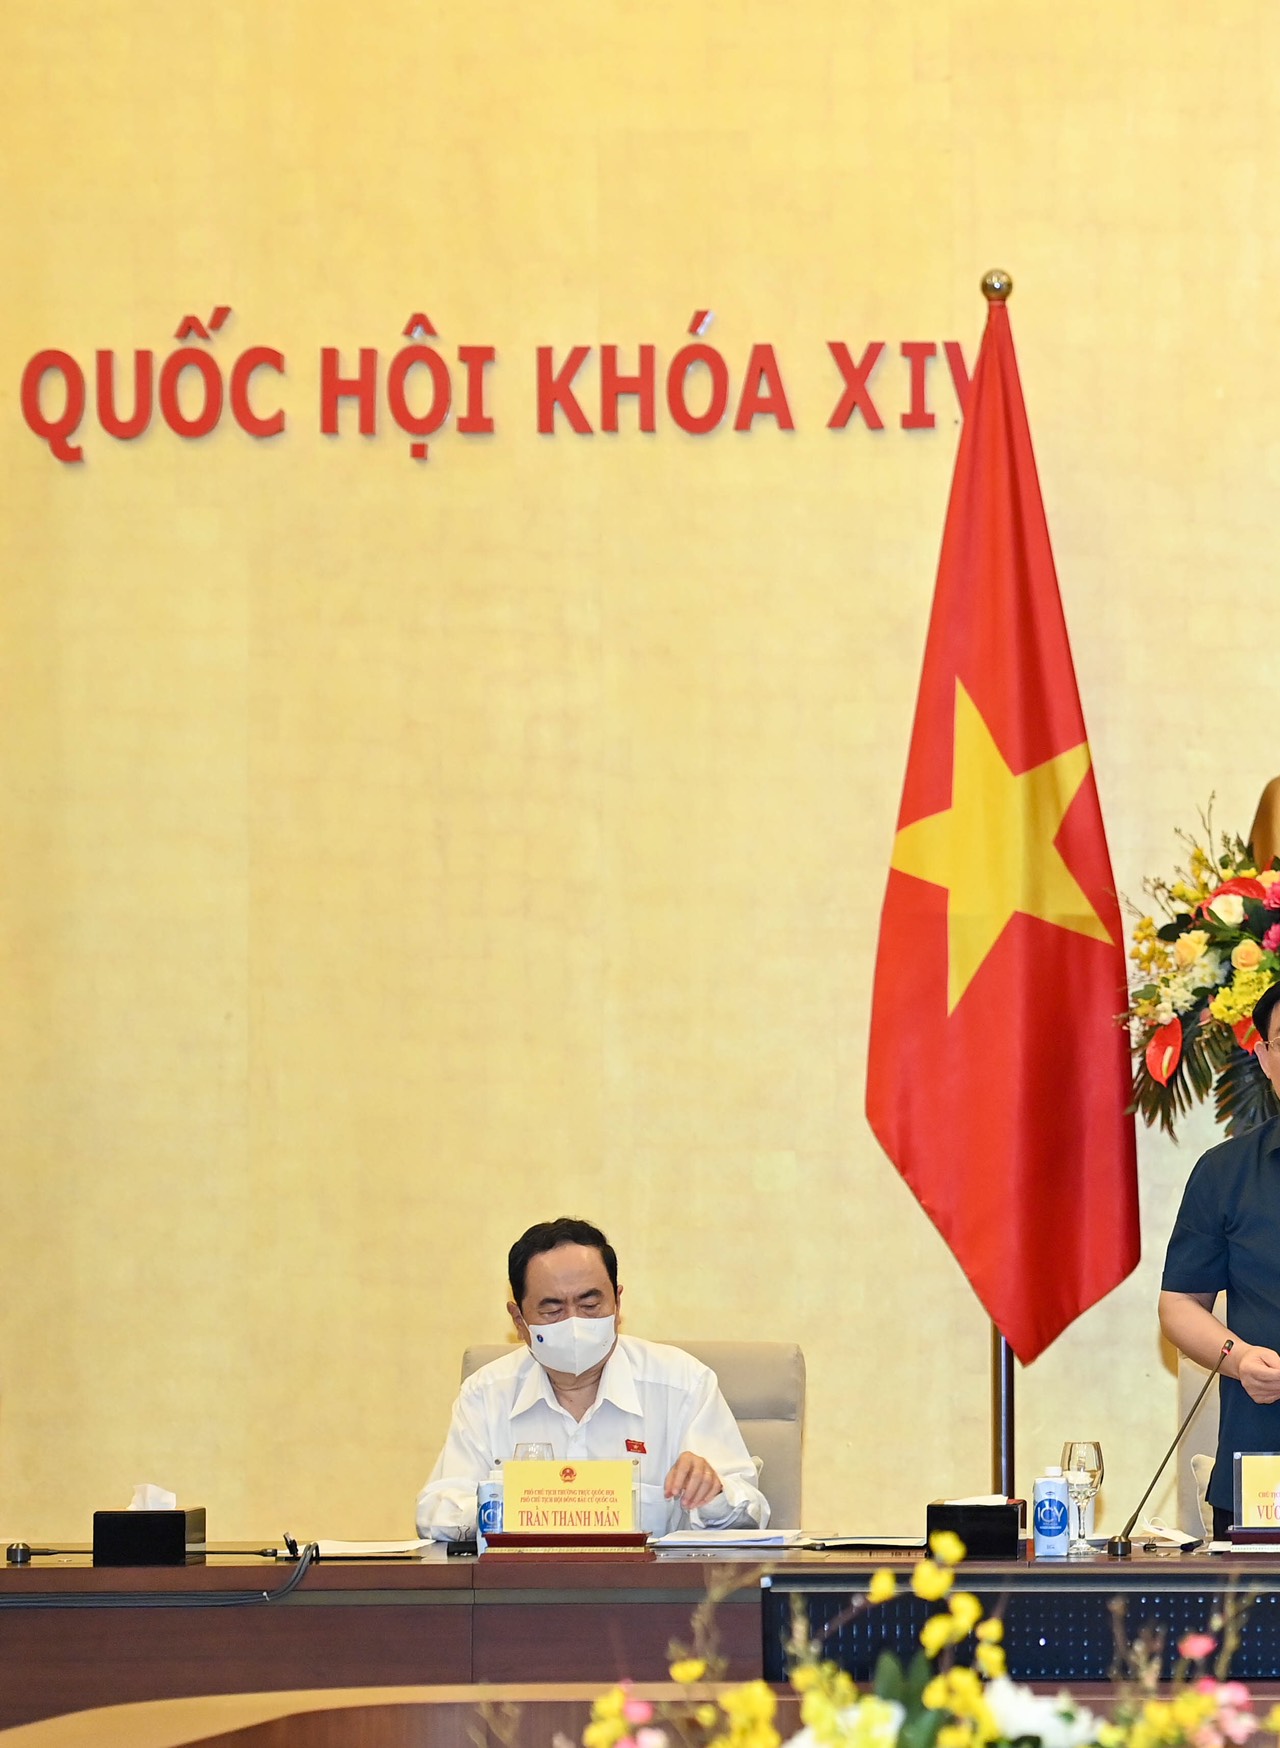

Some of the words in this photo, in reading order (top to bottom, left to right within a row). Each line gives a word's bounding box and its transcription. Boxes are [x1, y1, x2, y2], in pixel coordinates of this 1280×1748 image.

[20, 304, 287, 464] QUỐC
[319, 311, 498, 461] HỘI
[535, 309, 797, 436] KHÓA
[552, 1510, 591, 1527] THANH
[1037, 1506, 1065, 1523] ICY
